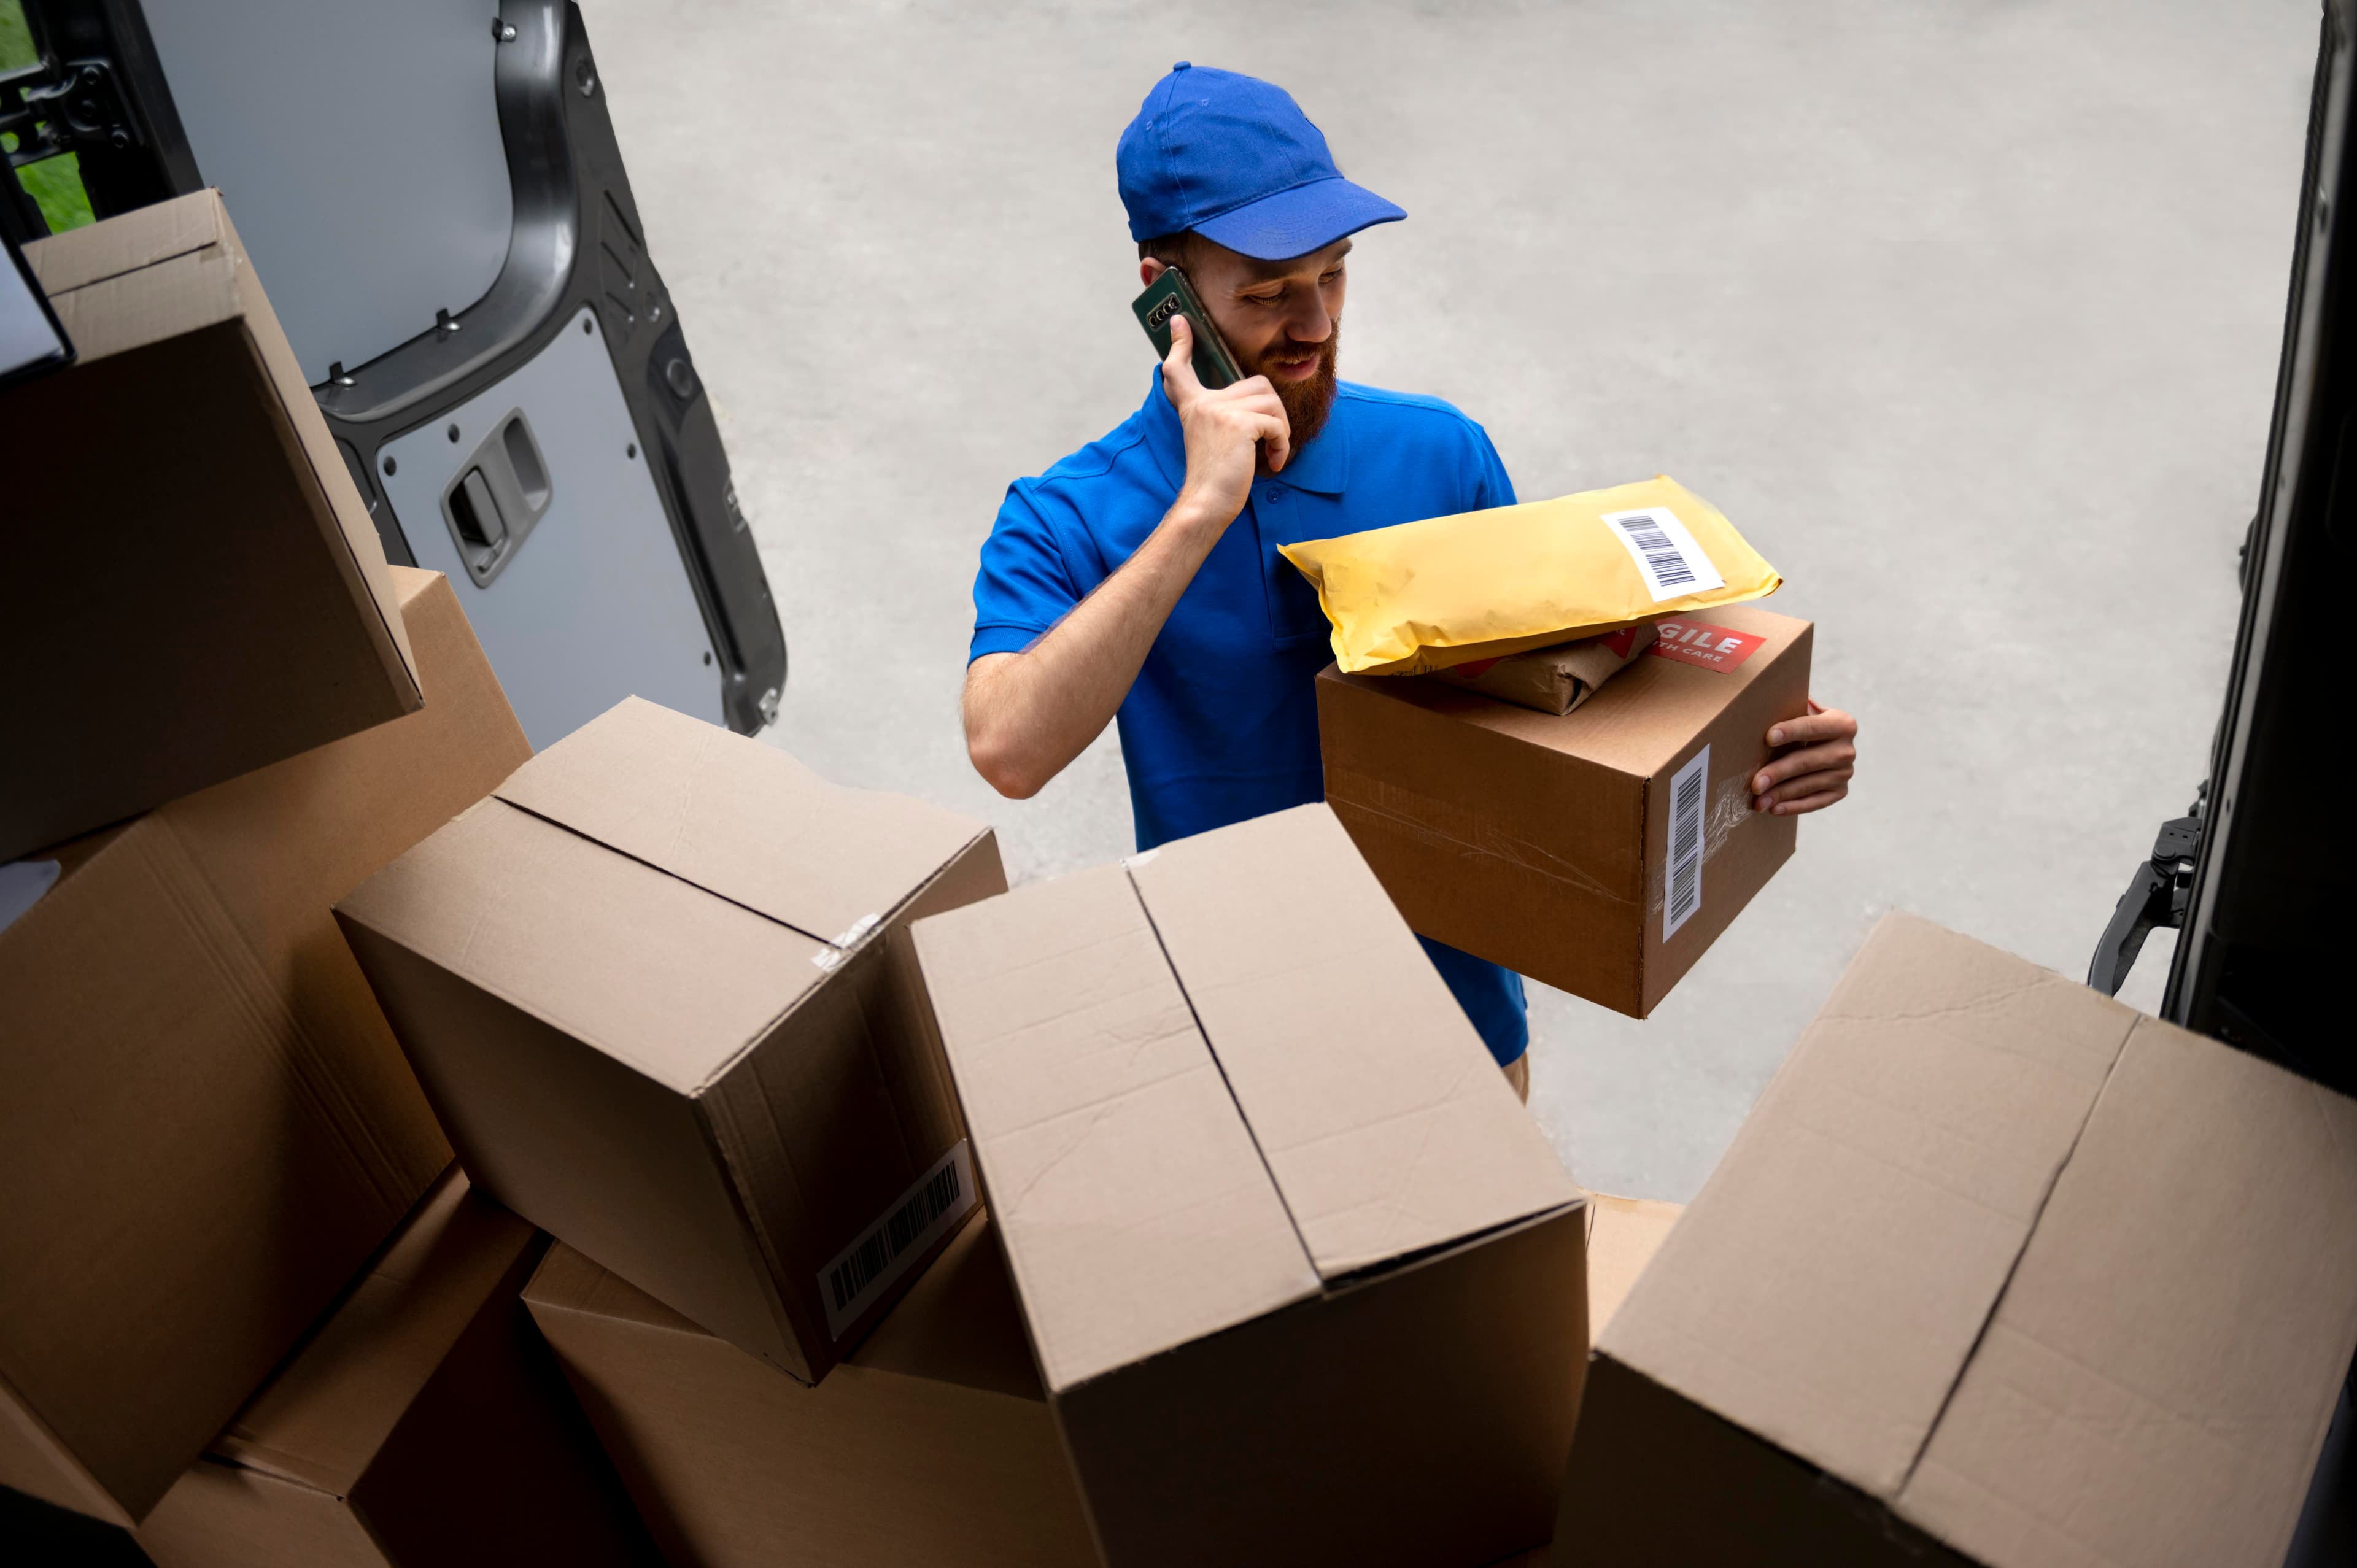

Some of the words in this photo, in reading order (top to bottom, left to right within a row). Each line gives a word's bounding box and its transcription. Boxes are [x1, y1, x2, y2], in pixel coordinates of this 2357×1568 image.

[1652, 641, 1679, 651] ITH
[1682, 648, 1724, 662] CARE
[1657, 623, 1743, 654] GILE
